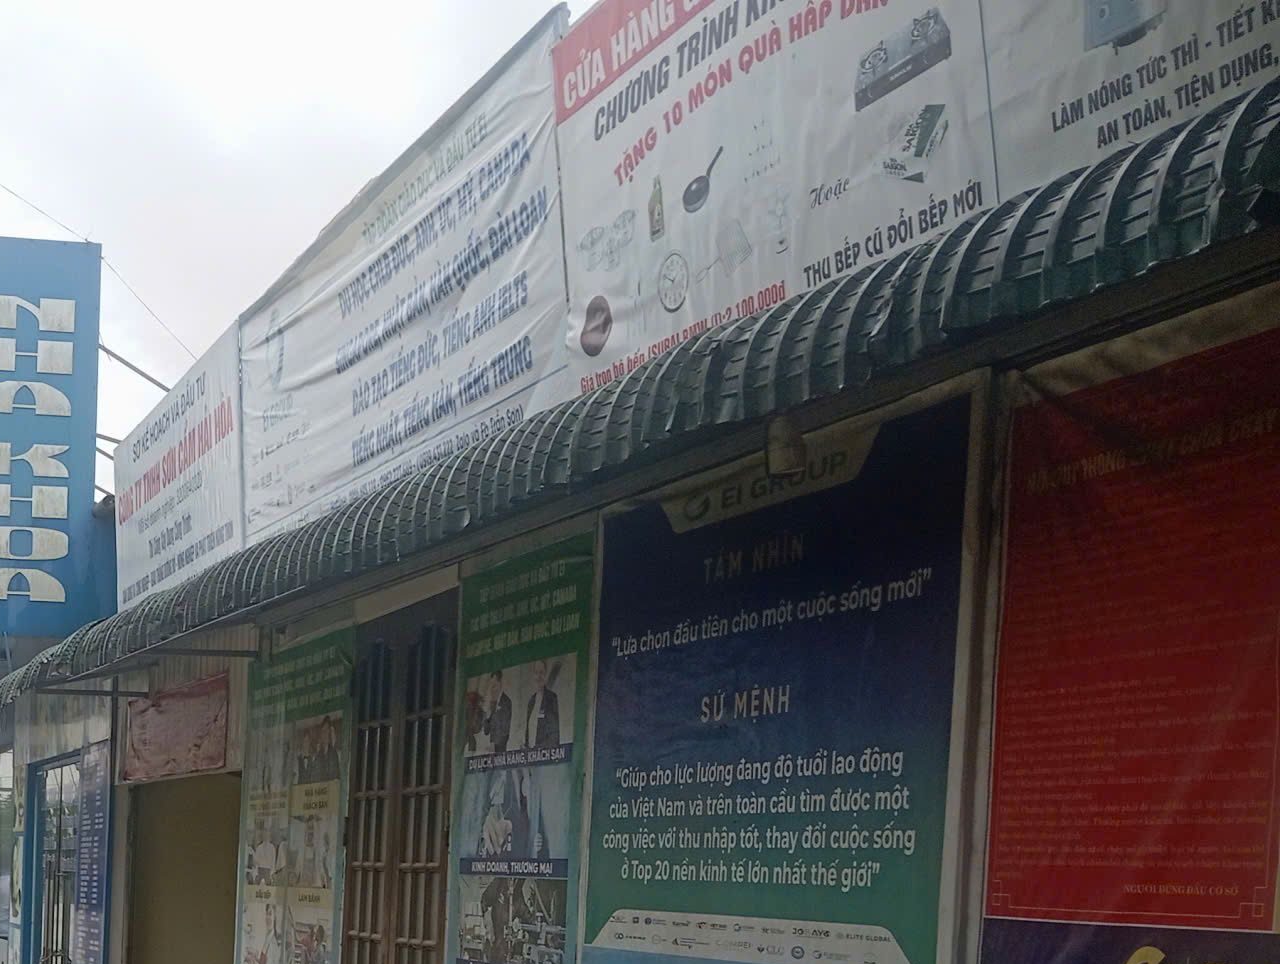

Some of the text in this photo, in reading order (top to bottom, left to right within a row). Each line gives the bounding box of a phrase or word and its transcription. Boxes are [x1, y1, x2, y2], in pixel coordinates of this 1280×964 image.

[563, 49, 606, 109] CỬA
[610, 2, 676, 70] HÀNG
[593, 1, 739, 141] CHƯƠNG TRÌNH
[1051, 102, 1084, 132] LÀM
[1087, 74, 1132, 114] NÓNG
[1136, 55, 1167, 89] TỨC
[1171, 33, 1200, 70] THÌ
[1216, 4, 1254, 47] TIẾT
[614, 127, 658, 186] TẶNG
[663, 101, 682, 133] 10
[688, 60, 733, 113] MÓN
[738, 21, 782, 73] QUÀ
[789, 1, 832, 43] HẤP
[1097, 43, 1279, 148] AN TOÀN, TIỆN DỤNG,
[809, 177, 850, 211] Hoặc
[804, 181, 982, 286] THU BẾP CŨ ĐỔI BẾP MỚI
[490, 335, 532, 391] TRUNG
[640, 630, 670, 657] chọn
[673, 621, 697, 647] đầu
[701, 616, 729, 642] tiên
[731, 608, 757, 634] cho
[762, 603, 792, 631] một
[797, 591, 835, 622] cuộc
[839, 579, 881, 611] sống
[699, 683, 792, 724] SỨ MỆNH
[528, 748, 550, 763] KHÁCH
[551, 747, 565, 763] SẠN
[649, 765, 671, 786] cho
[675, 763, 693, 786] lực
[696, 761, 733, 788] lượng
[736, 757, 771, 785] đang
[774, 755, 794, 783] độ
[797, 747, 827, 776] tuổi
[831, 750, 855, 776] lao
[858, 747, 903, 779] động
[609, 784, 910, 822] của Việt Nam và trên toàn cầu tìm được một
[511, 860, 538, 874] THƯƠNG
[539, 863, 552, 876] MẠI
